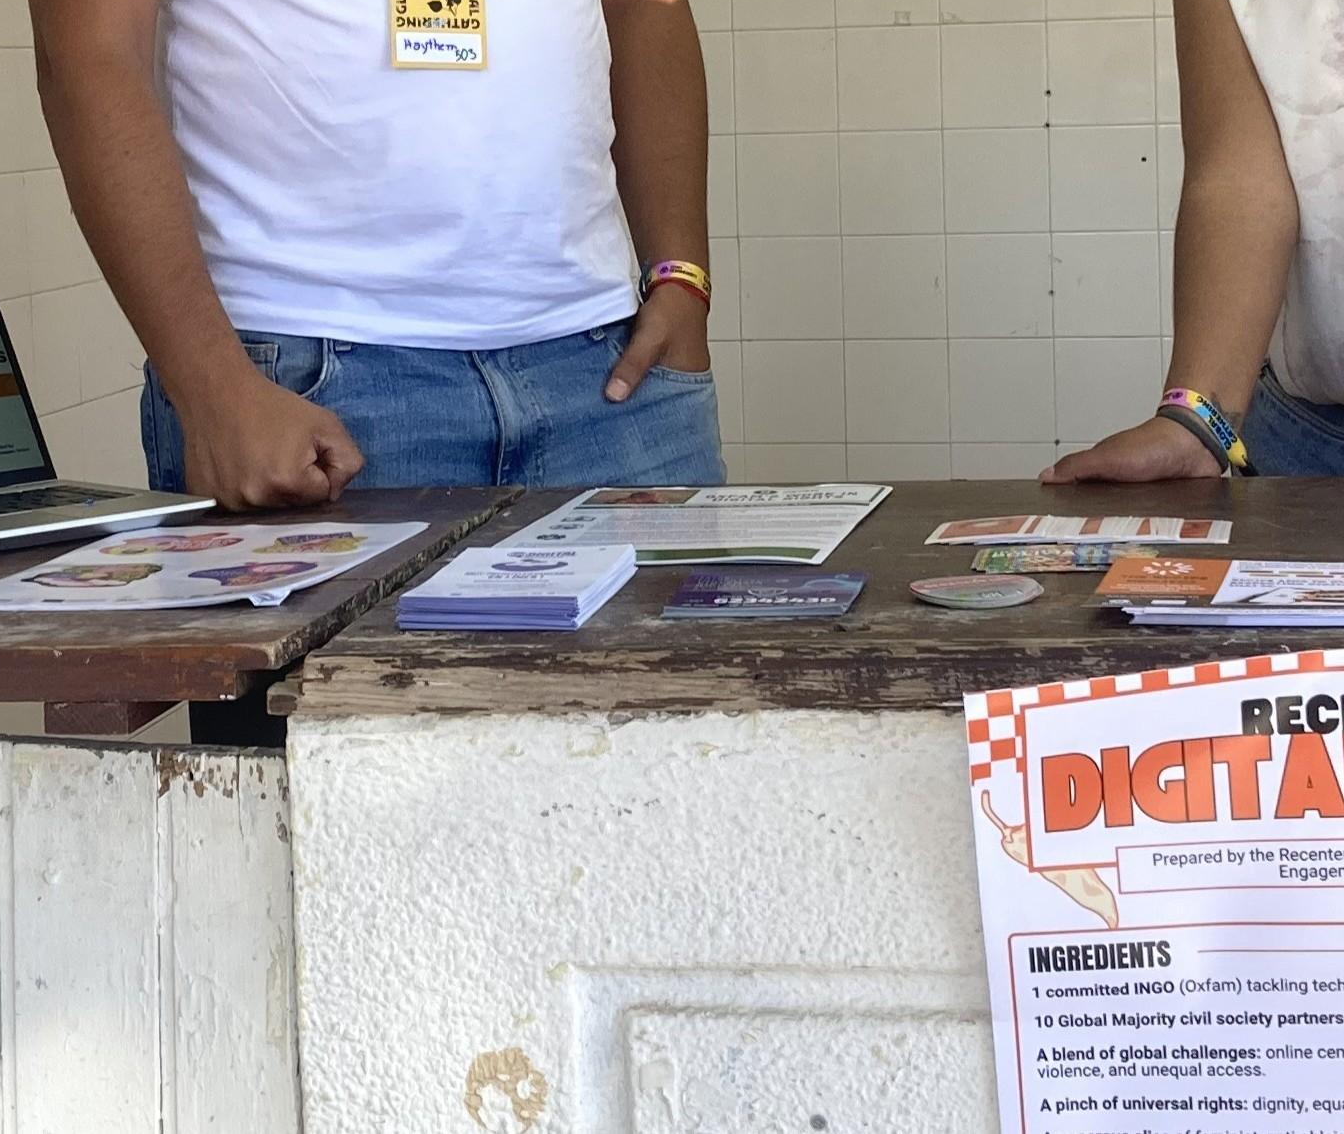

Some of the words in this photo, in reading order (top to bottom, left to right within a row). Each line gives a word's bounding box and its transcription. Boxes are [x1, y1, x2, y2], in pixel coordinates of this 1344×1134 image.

[1153, 849, 1222, 868] Prepared
[1227, 848, 1245, 866] by
[1249, 848, 1274, 862] the
[1028, 941, 1171, 973] INGREDIENTS
[1032, 986, 1039, 998] 1
[1046, 982, 1130, 998] committed
[1134, 980, 1174, 995] INGO
[1180, 978, 1242, 996] (Oxfam)
[1246, 978, 1308, 995] tackling
[1034, 1015, 1054, 1028] 10
[1058, 1013, 1107, 1028] Global
[1112, 1012, 1176, 1030] Majority
[1180, 1010, 1212, 1025] civil
[1216, 1011, 1273, 1028] society
[1277, 1012, 1344, 1028] partners
[1036, 1048, 1048, 1062] A
[1052, 1046, 1095, 1061] blend
[1099, 1045, 1115, 1060] of
[1119, 1044, 1167, 1063] global
[1171, 1044, 1261, 1062] challenges:
[1266, 1044, 1313, 1059] online
[1037, 1064, 1104, 1078] violence,
[1108, 1062, 1136, 1076] and
[1141, 1062, 1202, 1080] unequal
[1207, 1066, 1266, 1076] access.
[1040, 1098, 1052, 1112] A
[1056, 1096, 1098, 1114] pinch
[1102, 1095, 1118, 1110] of
[1122, 1096, 1193, 1110] universal
[1198, 1096, 1248, 1114] rights:
[1252, 1096, 1308, 1114] dignity,
